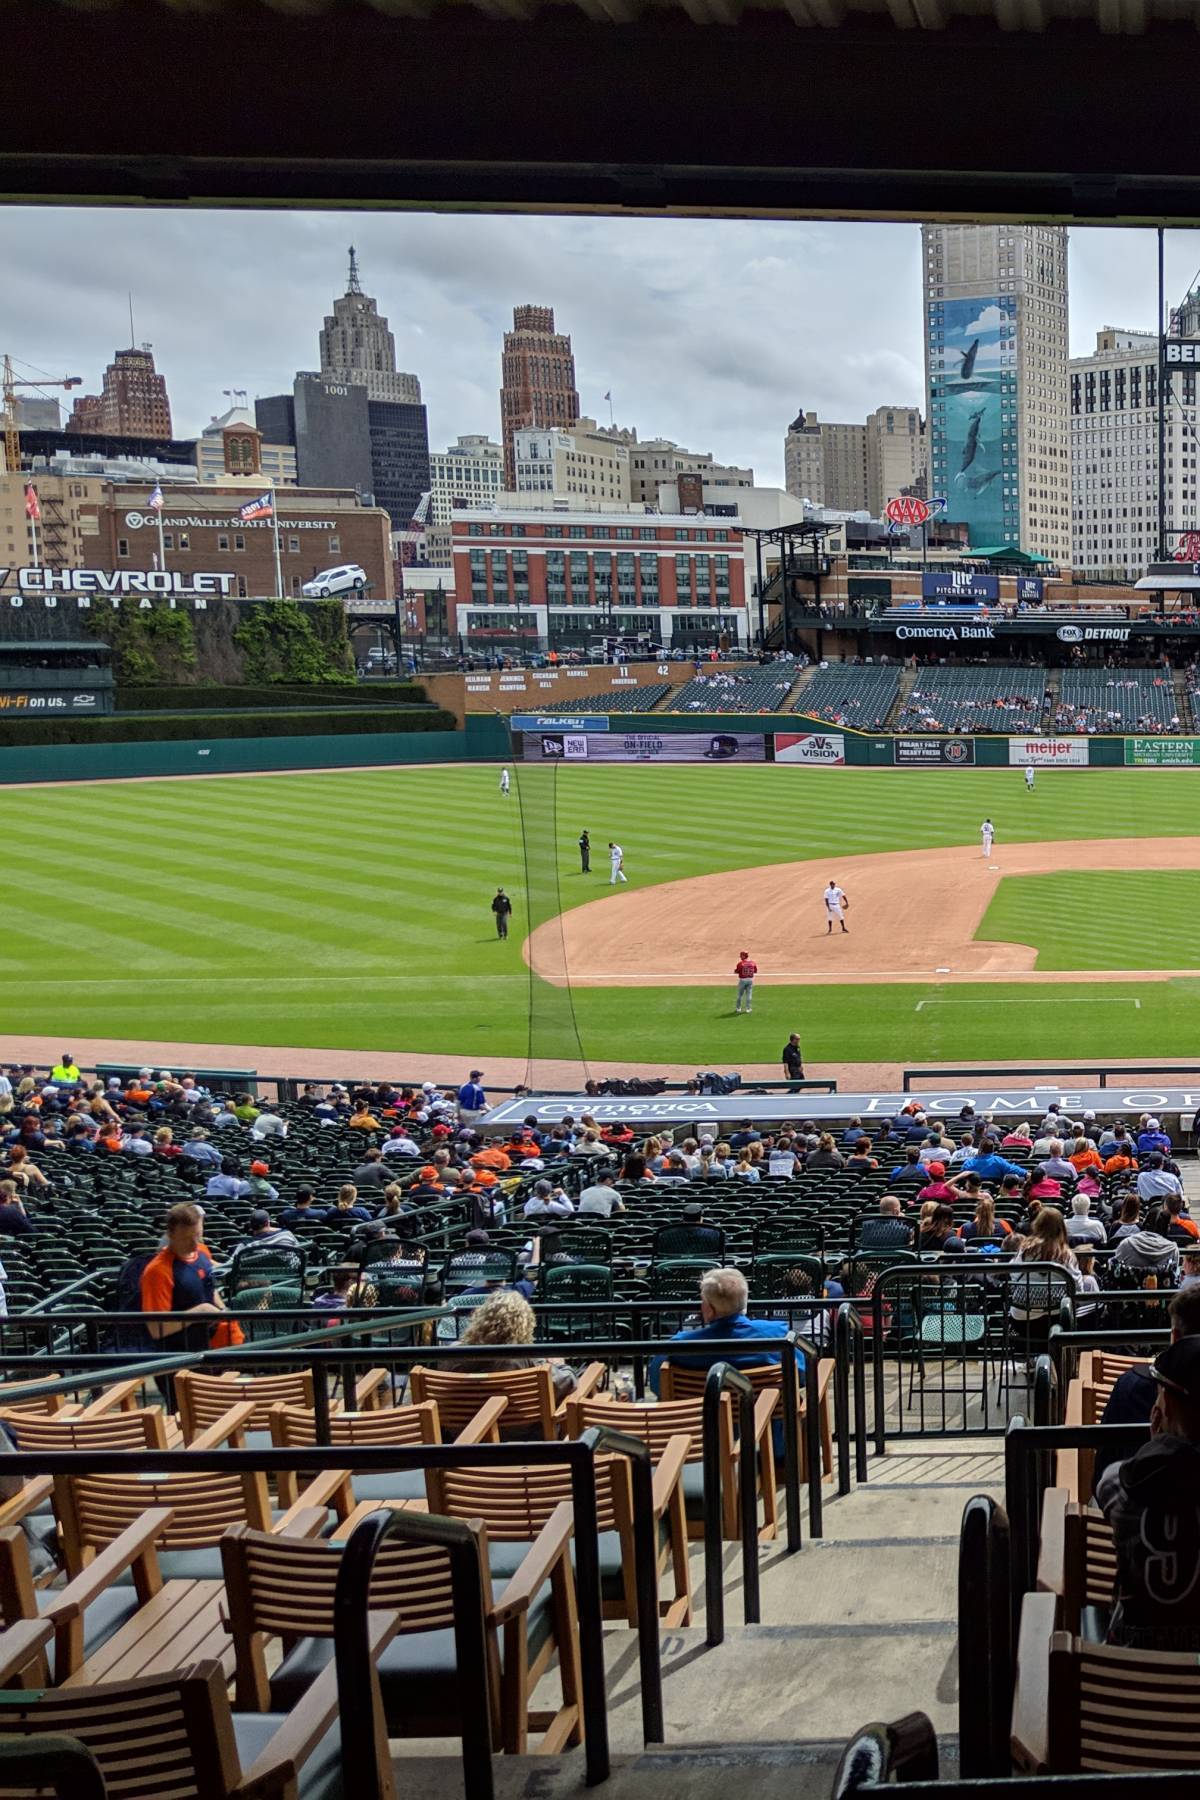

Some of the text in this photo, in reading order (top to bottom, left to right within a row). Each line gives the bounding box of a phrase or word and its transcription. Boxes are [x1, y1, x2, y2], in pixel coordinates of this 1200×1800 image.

[324, 385, 348, 396] 1001
[889, 499, 926, 523] AAA
[144, 515, 337, 529] GRAND VALLEY STATE UNIVERSITY
[19, 568, 236, 593] CHEVROLET
[952, 571, 973, 587] Lite
[936, 586, 987, 595] PITCHER'S PUB
[10, 596, 208, 609] OUNTAIN
[961, 626, 995, 639] Bank
[1063, 628, 1131, 641] FOX DETROIT
[620, 666, 669, 677] 11 42
[30, 698, 45, 707] on
[48, 698, 67, 707] us.
[1026, 739, 1072, 756] meijer
[1134, 740, 1193, 752] EASTERN
[864, 1094, 1083, 1112] HOME
